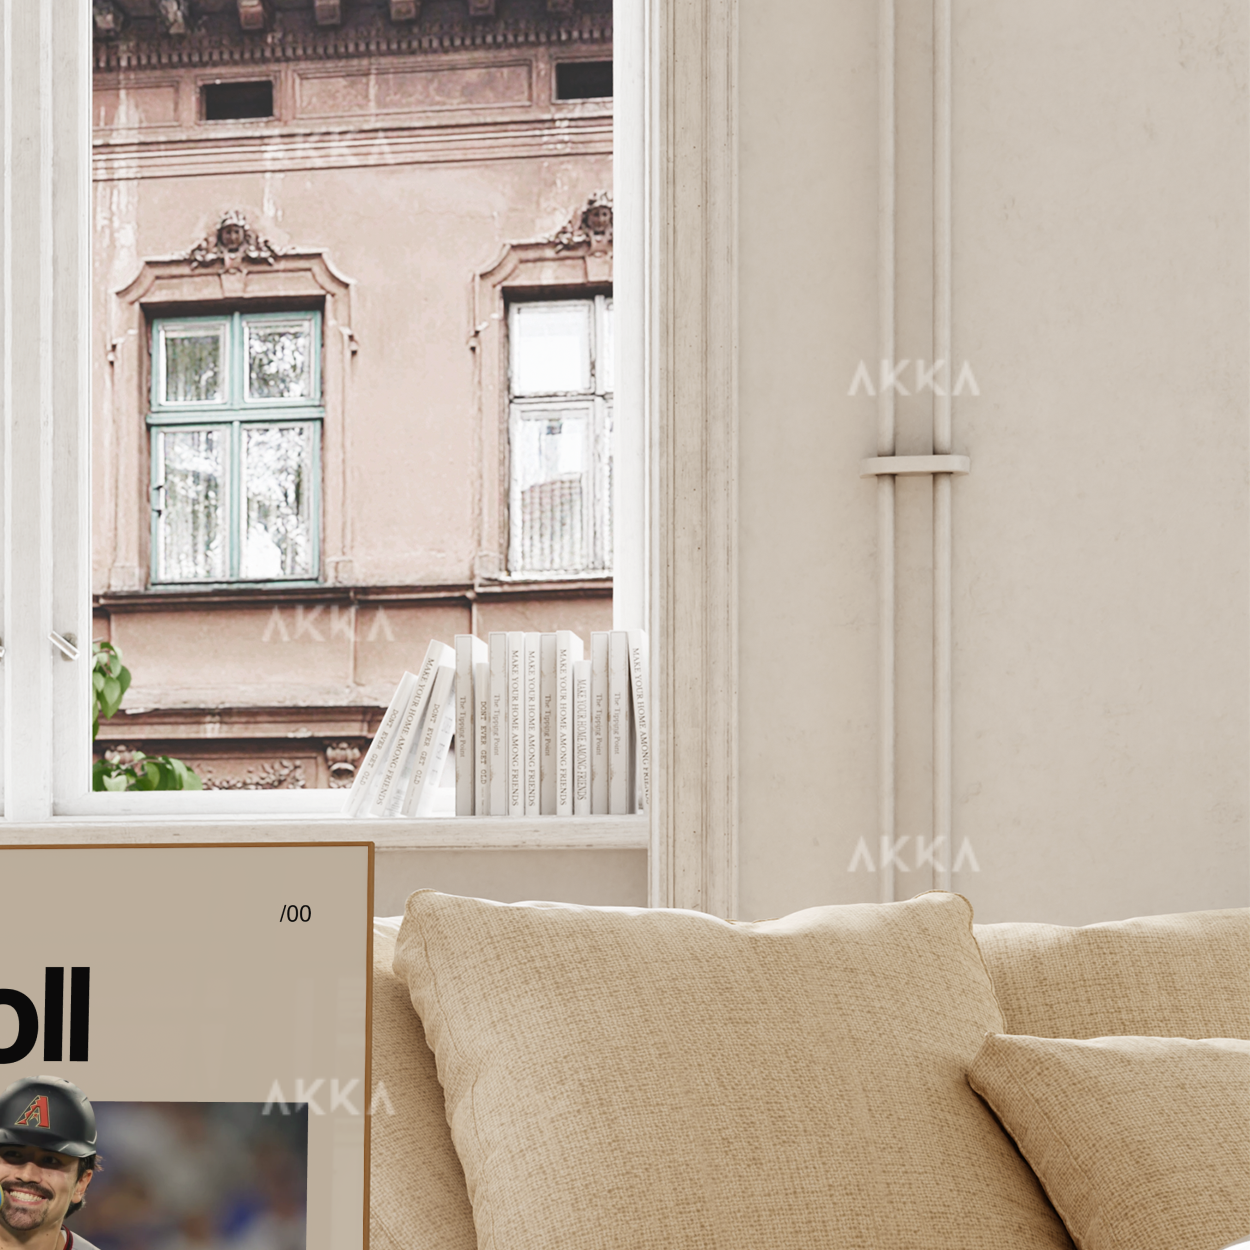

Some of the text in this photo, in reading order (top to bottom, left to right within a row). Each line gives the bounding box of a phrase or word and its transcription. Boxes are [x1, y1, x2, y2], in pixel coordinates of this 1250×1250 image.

[377, 658, 435, 805] MAKE YOUR HOME AMONG FRIENDS
[414, 704, 440, 785] DONT EVER GET OLD
[633, 648, 649, 767] MAKE YOUR HOME AMONG
[279, 904, 312, 924] /00
